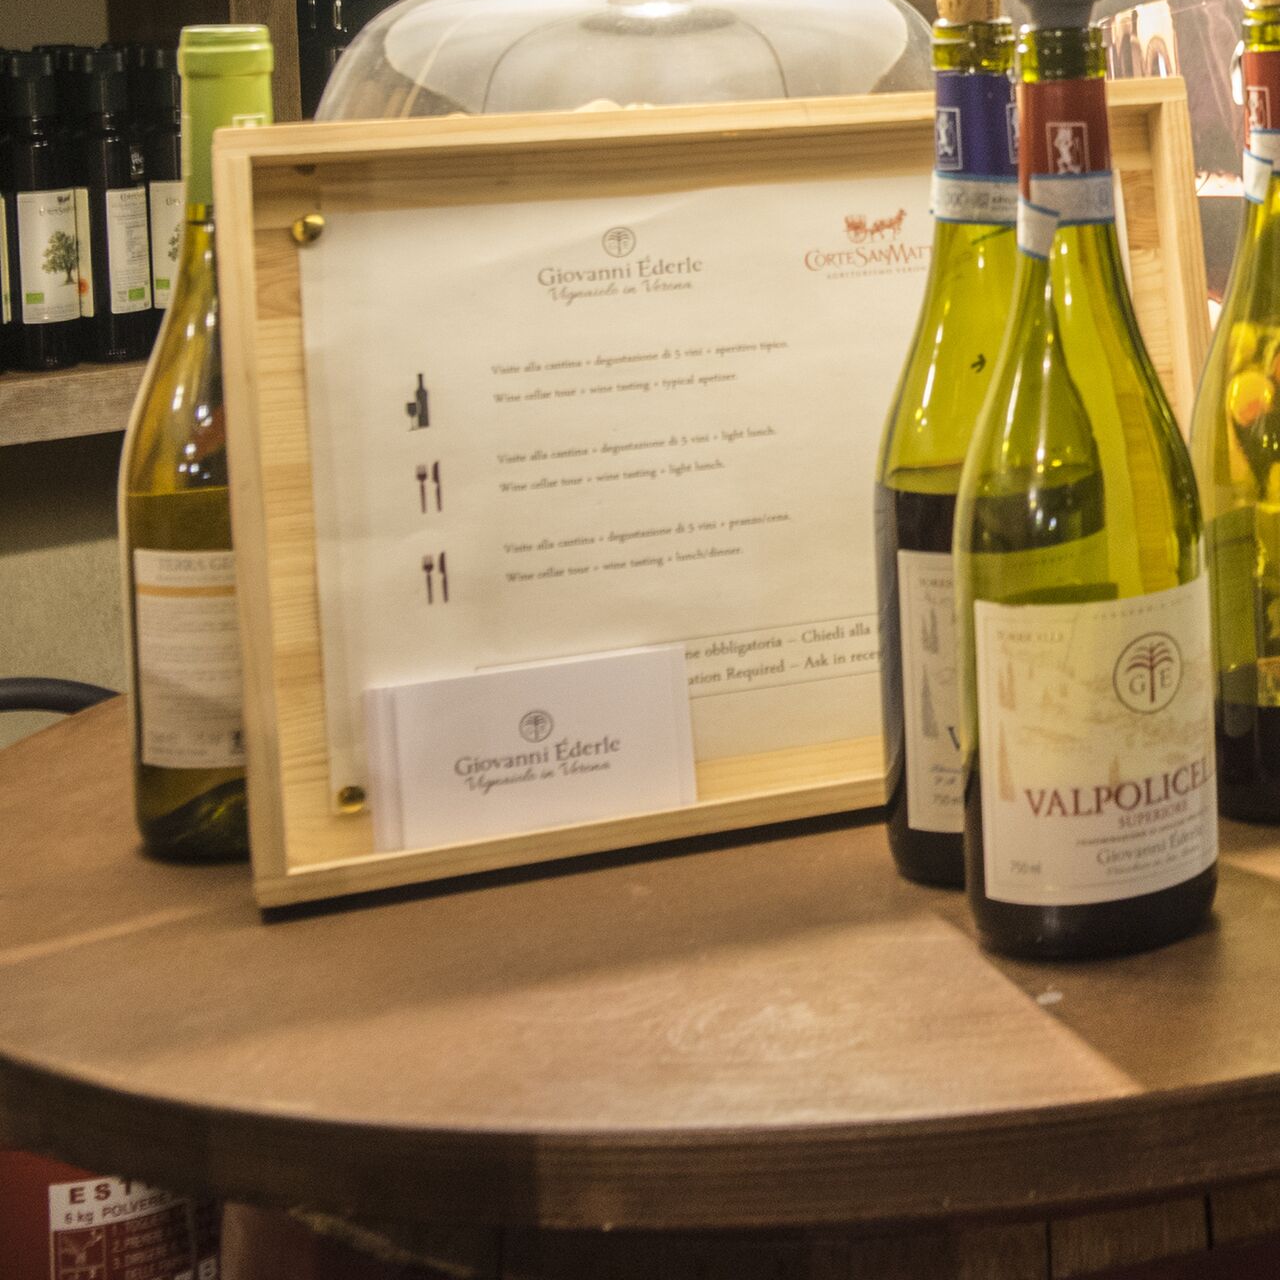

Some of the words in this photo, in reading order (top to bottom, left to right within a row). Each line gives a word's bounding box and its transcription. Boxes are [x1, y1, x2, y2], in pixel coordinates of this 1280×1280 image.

[704, 636, 783, 658] obbligatoria
[801, 626, 845, 645] Chiedi
[849, 622, 871, 638] alla
[726, 660, 785, 682] Required
[803, 651, 828, 670] Ask
[832, 651, 846, 665] in
